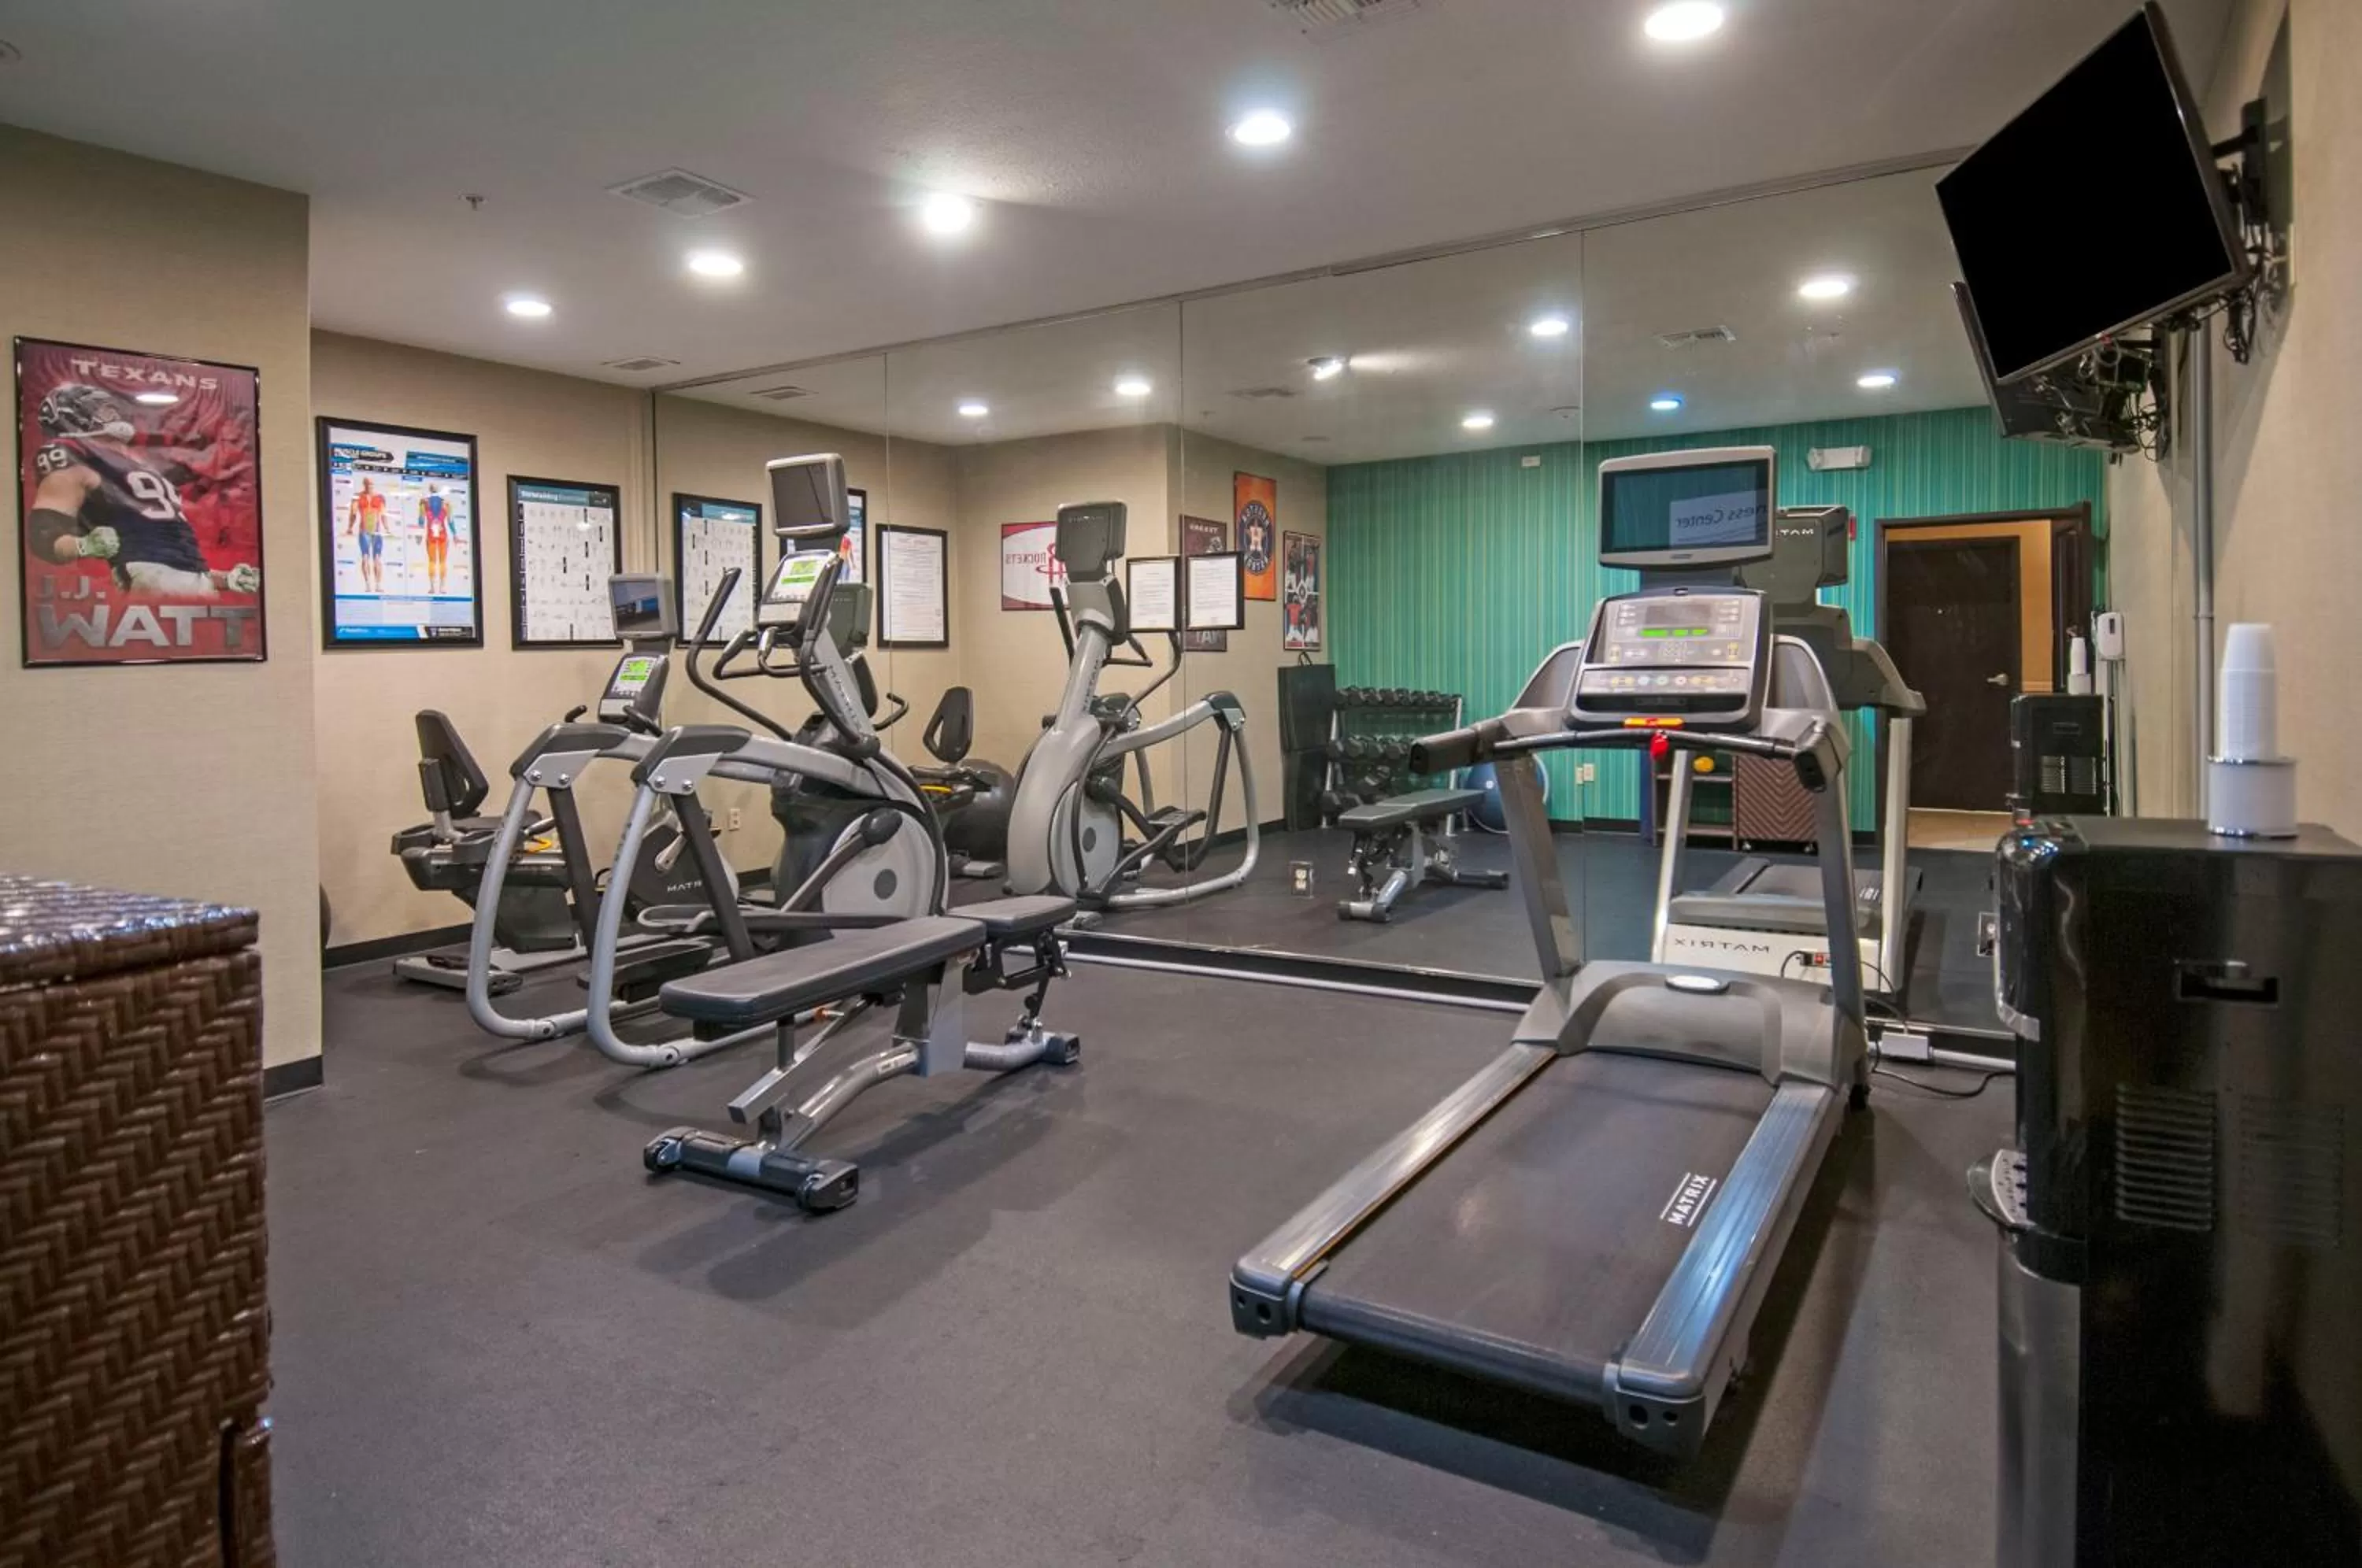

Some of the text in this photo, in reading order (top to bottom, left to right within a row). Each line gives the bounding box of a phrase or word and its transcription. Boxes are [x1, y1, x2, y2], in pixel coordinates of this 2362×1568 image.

[71, 358, 218, 390] TEXANS
[35, 575, 106, 600] J.J.
[36, 604, 257, 647] WATT
[667, 880, 703, 892] MATR
[1668, 1174, 1710, 1225] MATRIX
